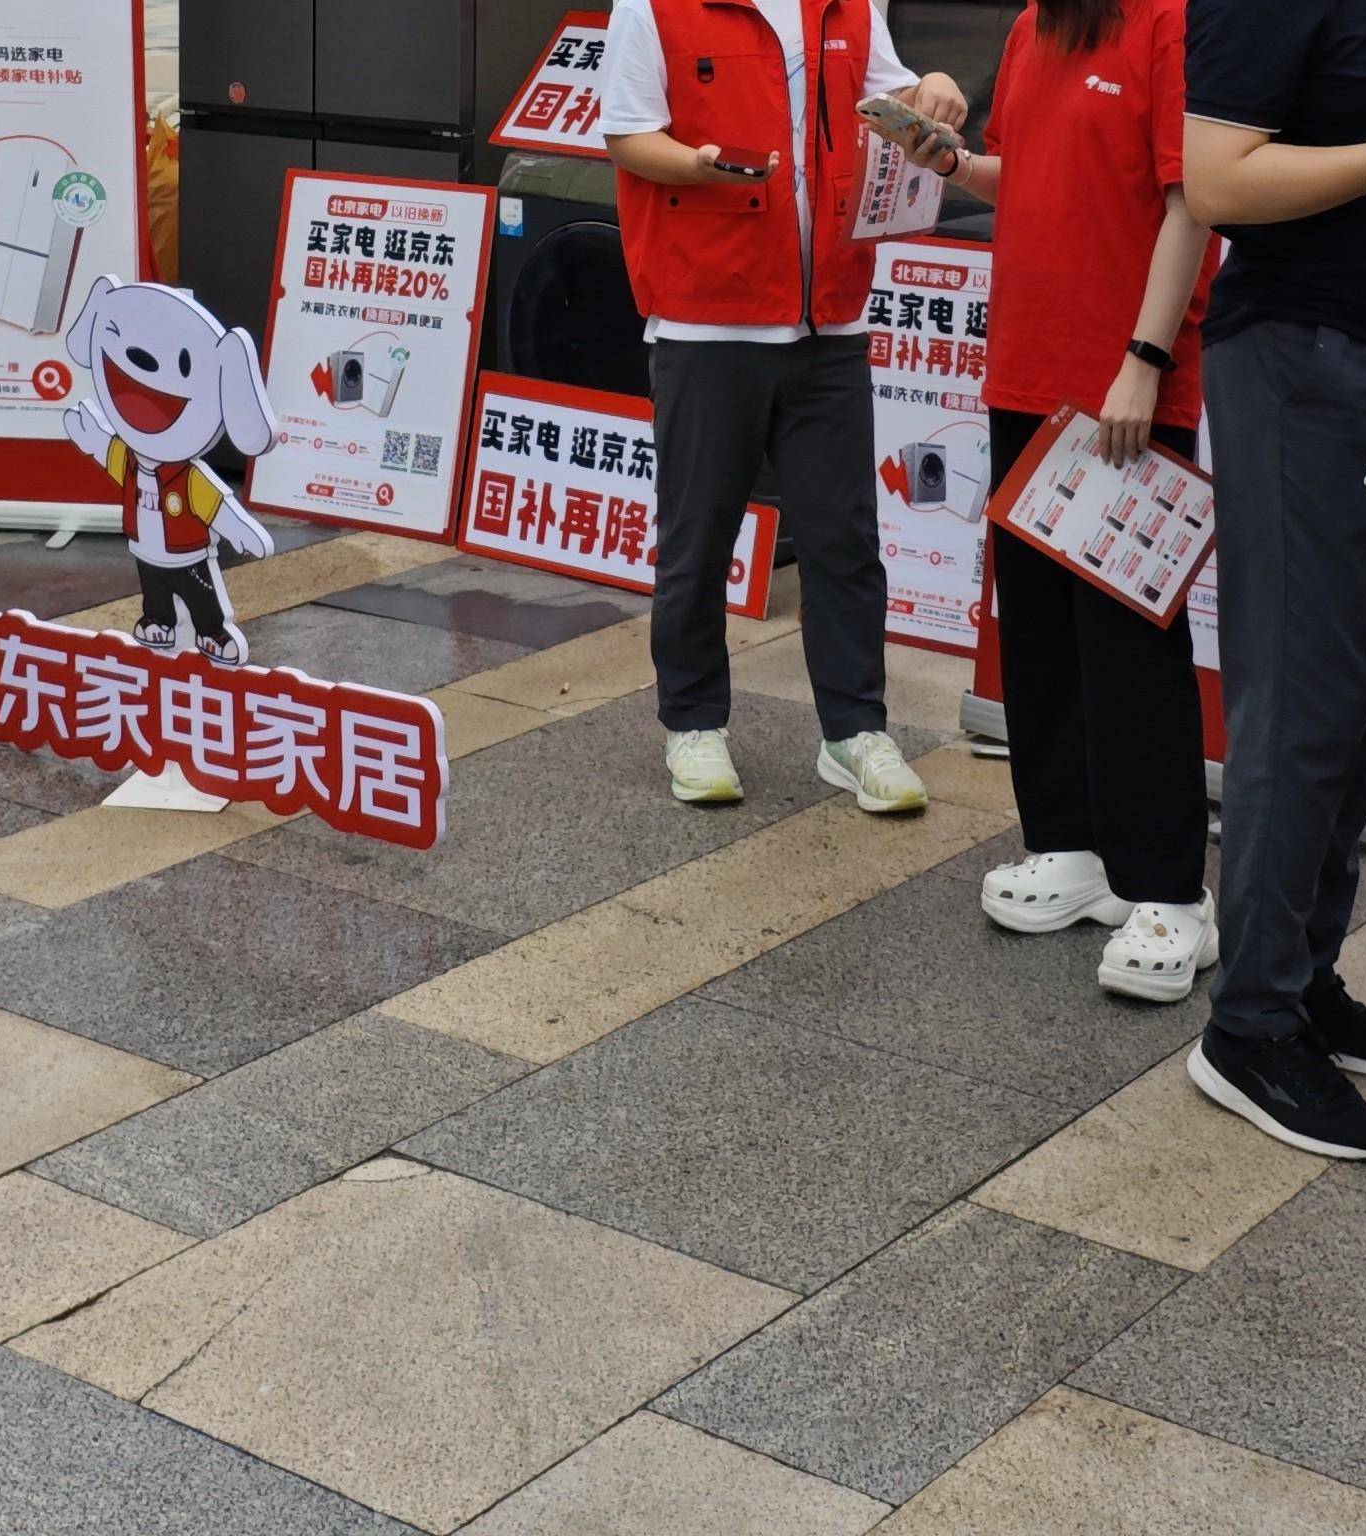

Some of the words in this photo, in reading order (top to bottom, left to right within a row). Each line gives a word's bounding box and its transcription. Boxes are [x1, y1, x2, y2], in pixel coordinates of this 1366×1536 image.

[546, 37, 606, 72] 买家
[329, 198, 383, 221] 北京家电
[390, 204, 444, 224] 以旧换新
[307, 220, 376, 258] 买家电
[383, 228, 456, 266] 逛京东
[304, 256, 450, 301] 国补再降20%
[895, 264, 961, 287] 北京家电
[300, 300, 362, 322] 冰箱洗衣机
[867, 288, 954, 335] 买家电
[868, 330, 986, 381] 国补再降
[481, 408, 561, 463] 买家电
[569, 426, 657, 480] 逛京东
